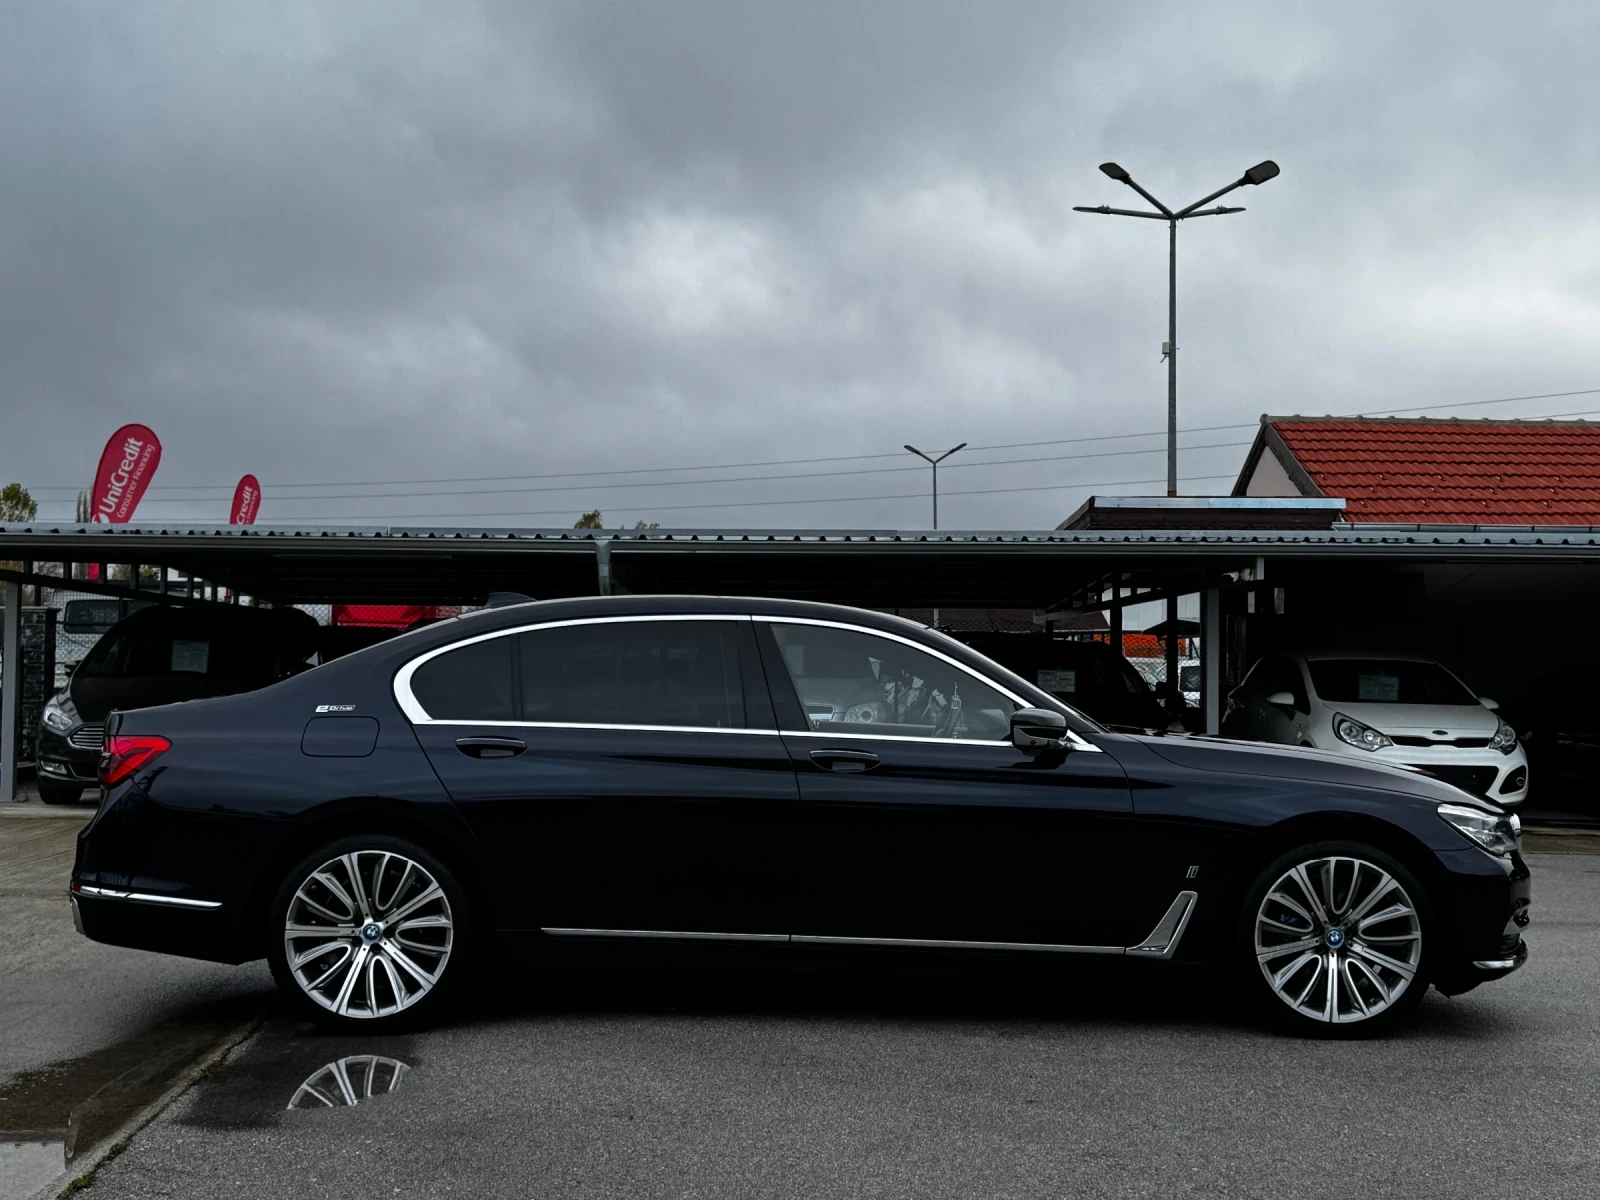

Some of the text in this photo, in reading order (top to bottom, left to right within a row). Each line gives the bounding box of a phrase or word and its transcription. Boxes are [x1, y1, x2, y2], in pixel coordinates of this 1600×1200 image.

[99, 437, 143, 513] UniCredit
[117, 444, 156, 519] Consumer Financing
